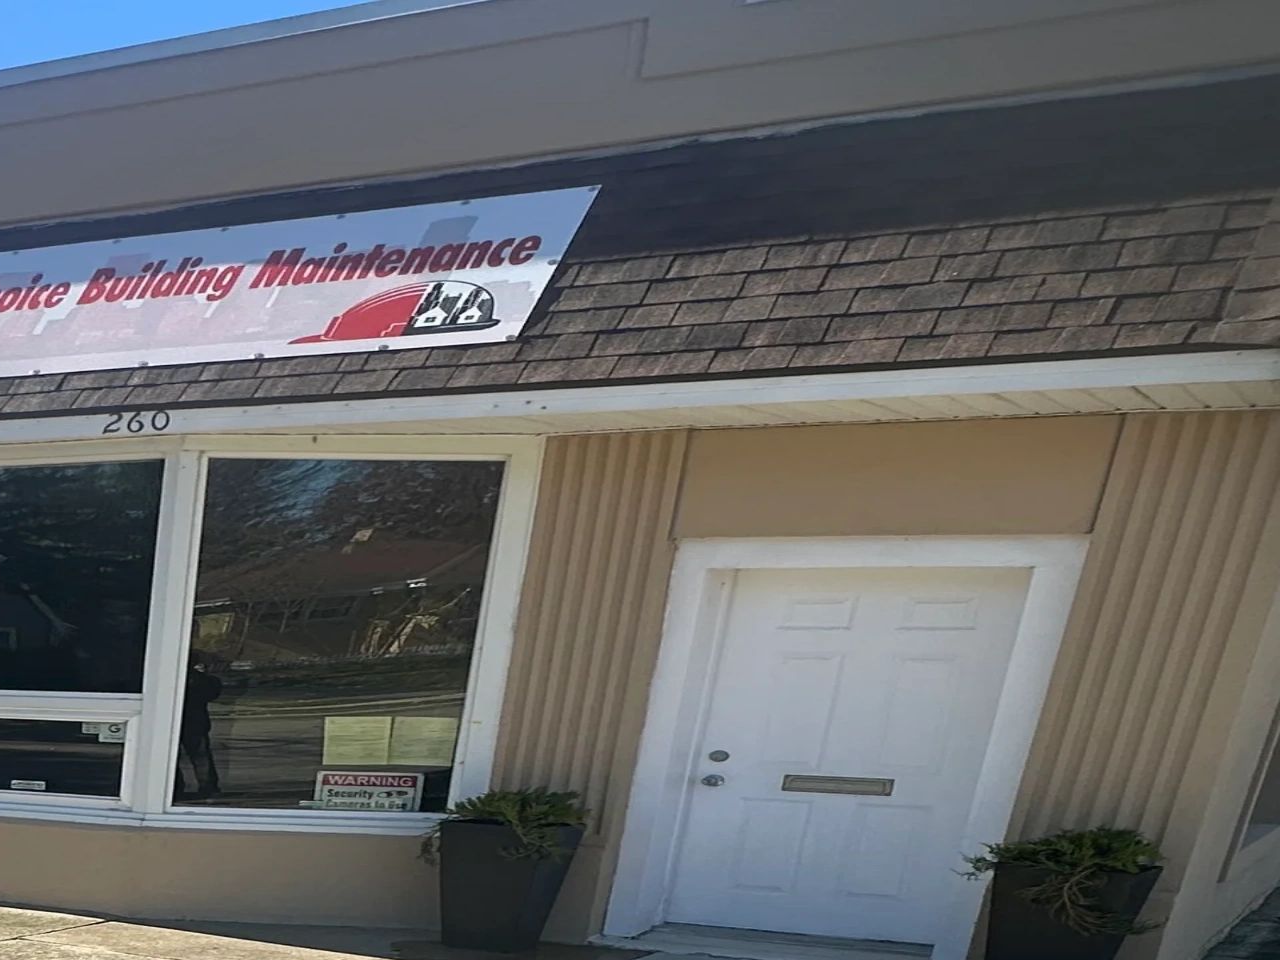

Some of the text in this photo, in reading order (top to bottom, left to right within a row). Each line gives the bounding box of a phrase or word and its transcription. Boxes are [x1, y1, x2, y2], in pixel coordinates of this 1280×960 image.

[76, 257, 244, 305] Building
[249, 235, 541, 289] Maintenance
[102, 410, 170, 434] 260
[328, 775, 413, 786] WARNING
[327, 788, 374, 800] Security
[326, 799, 372, 808] Cameras
[388, 800, 408, 809] Use
